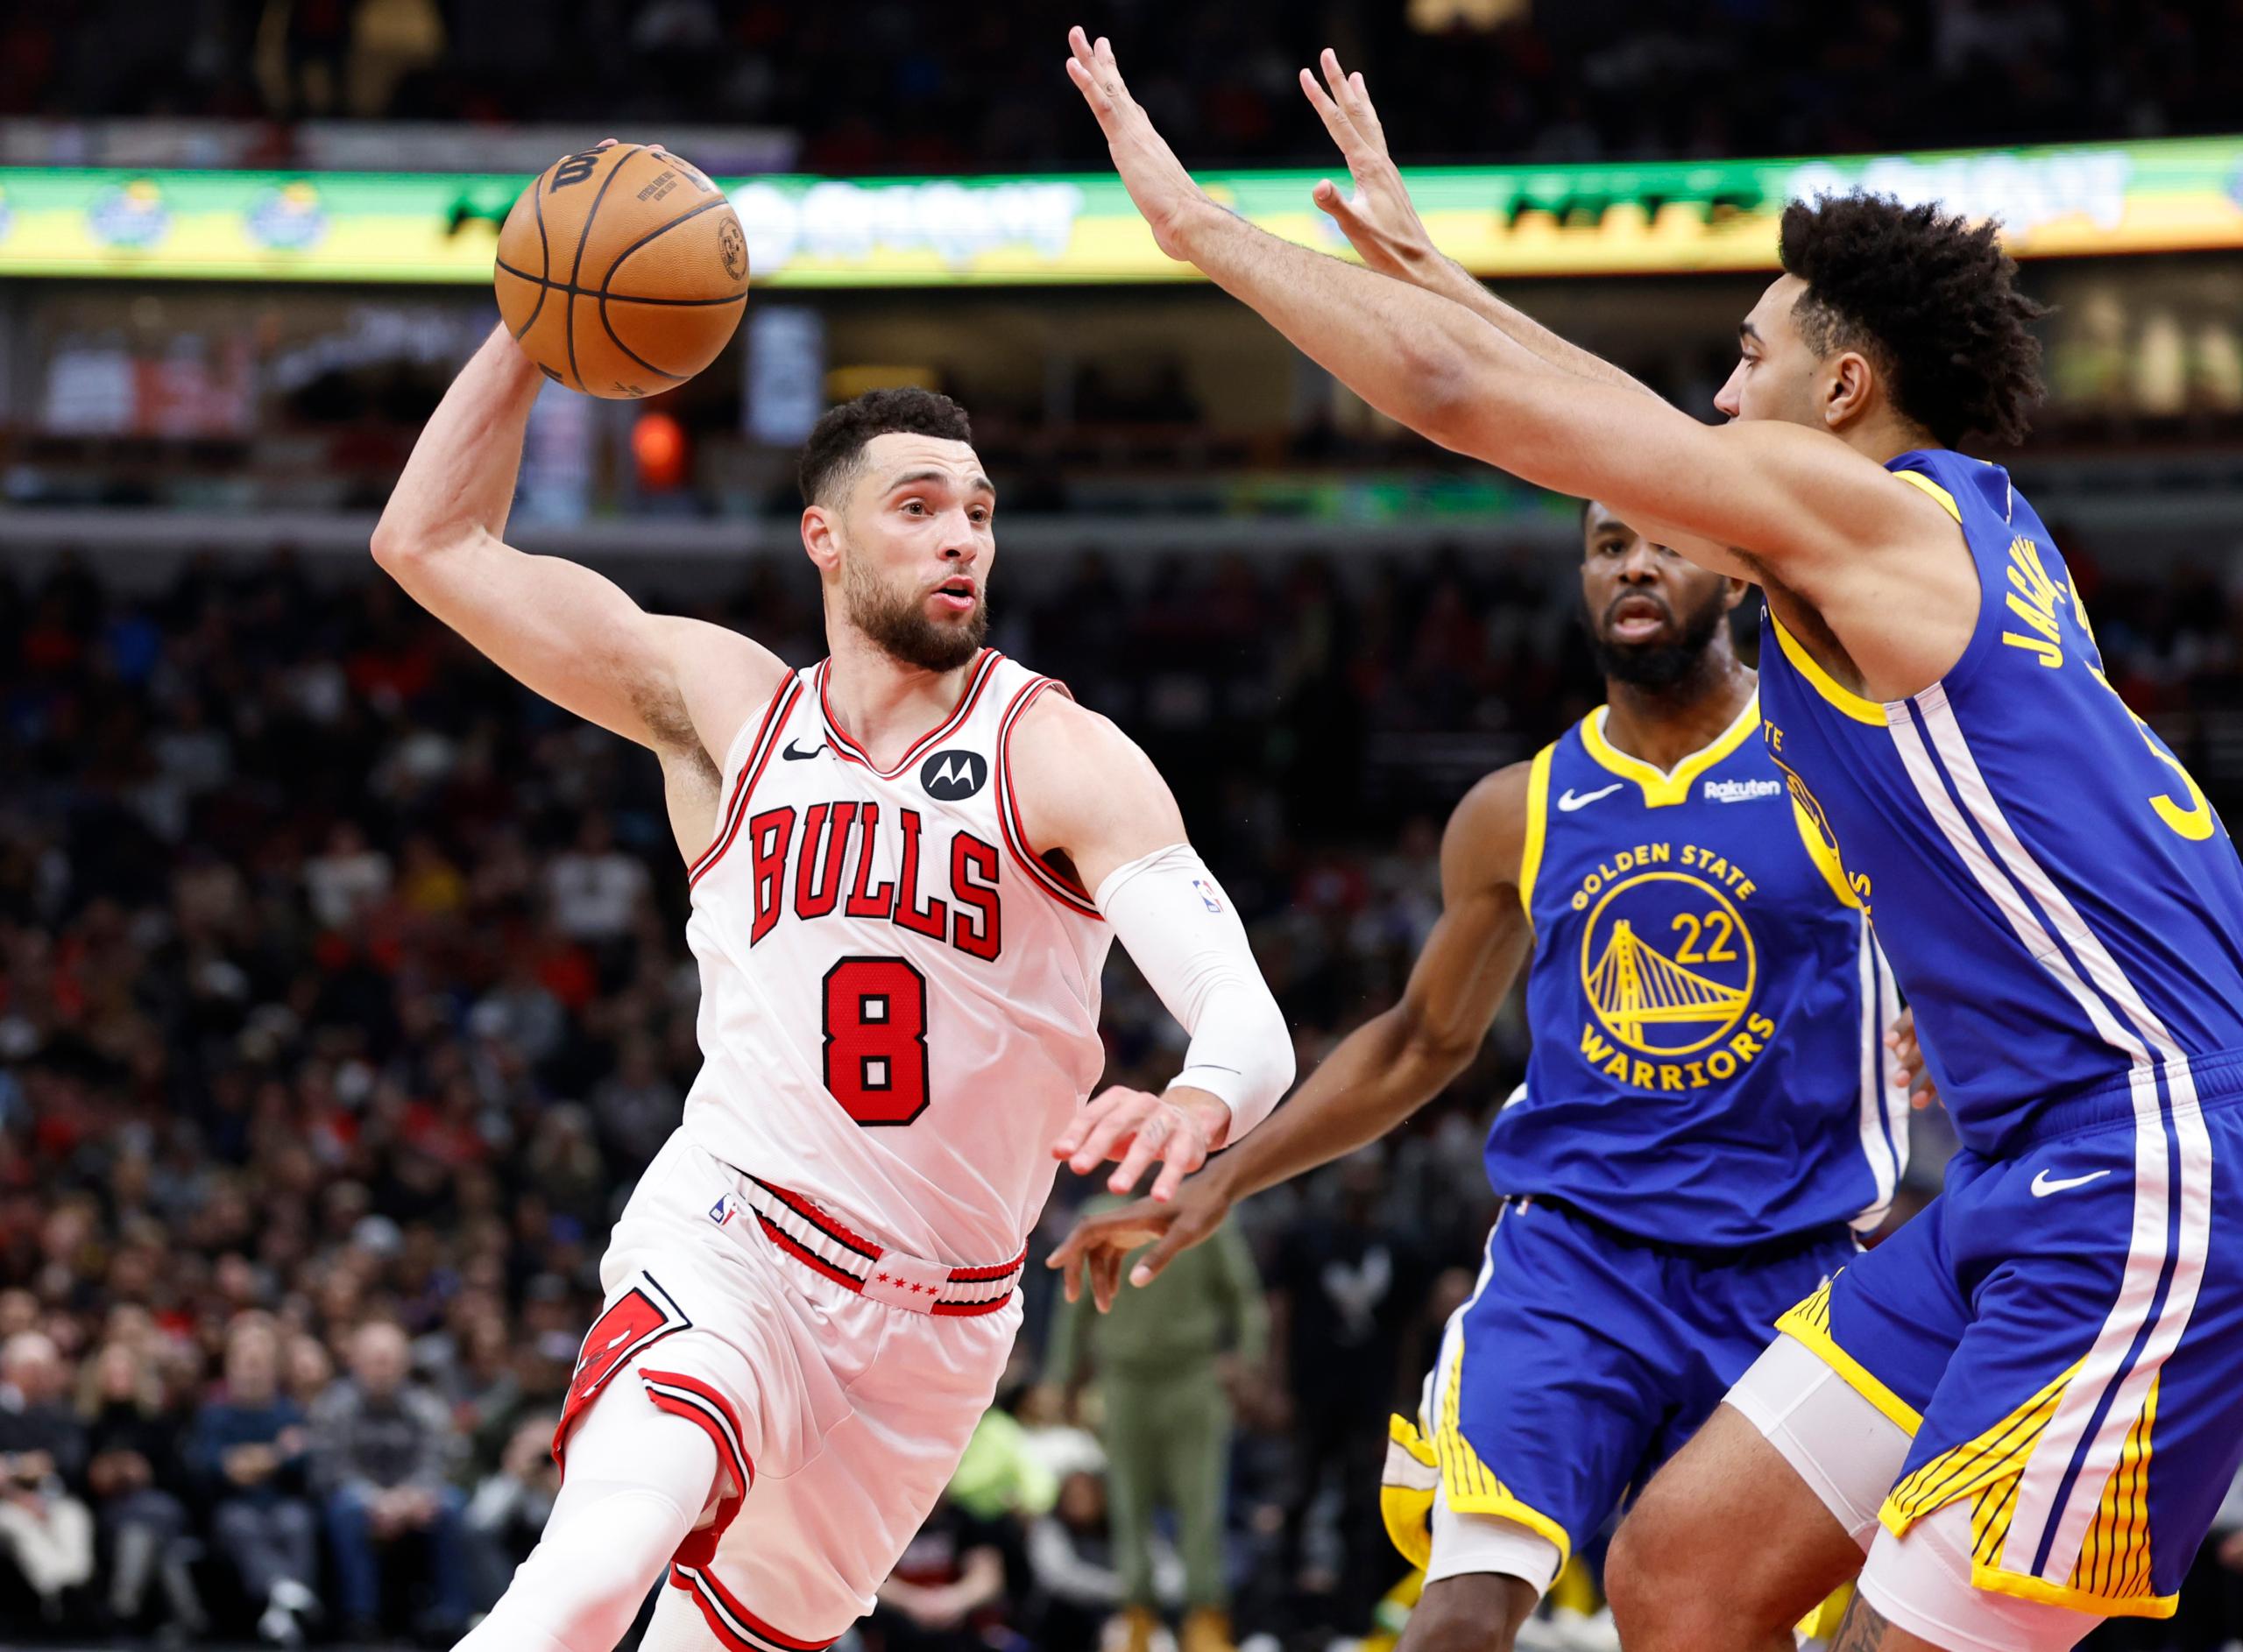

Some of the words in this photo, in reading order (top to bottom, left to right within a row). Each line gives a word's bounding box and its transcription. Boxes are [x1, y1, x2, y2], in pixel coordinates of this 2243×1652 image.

[1704, 779, 1780, 800] Rakuten
[749, 801, 1001, 962] BULLS
[1571, 843, 1670, 911] GOLDEN
[1680, 844, 1757, 901] STATE
[1671, 911, 1737, 964] 22
[822, 956, 930, 1126] 8
[1580, 1011, 1775, 1091] WARRIORS
